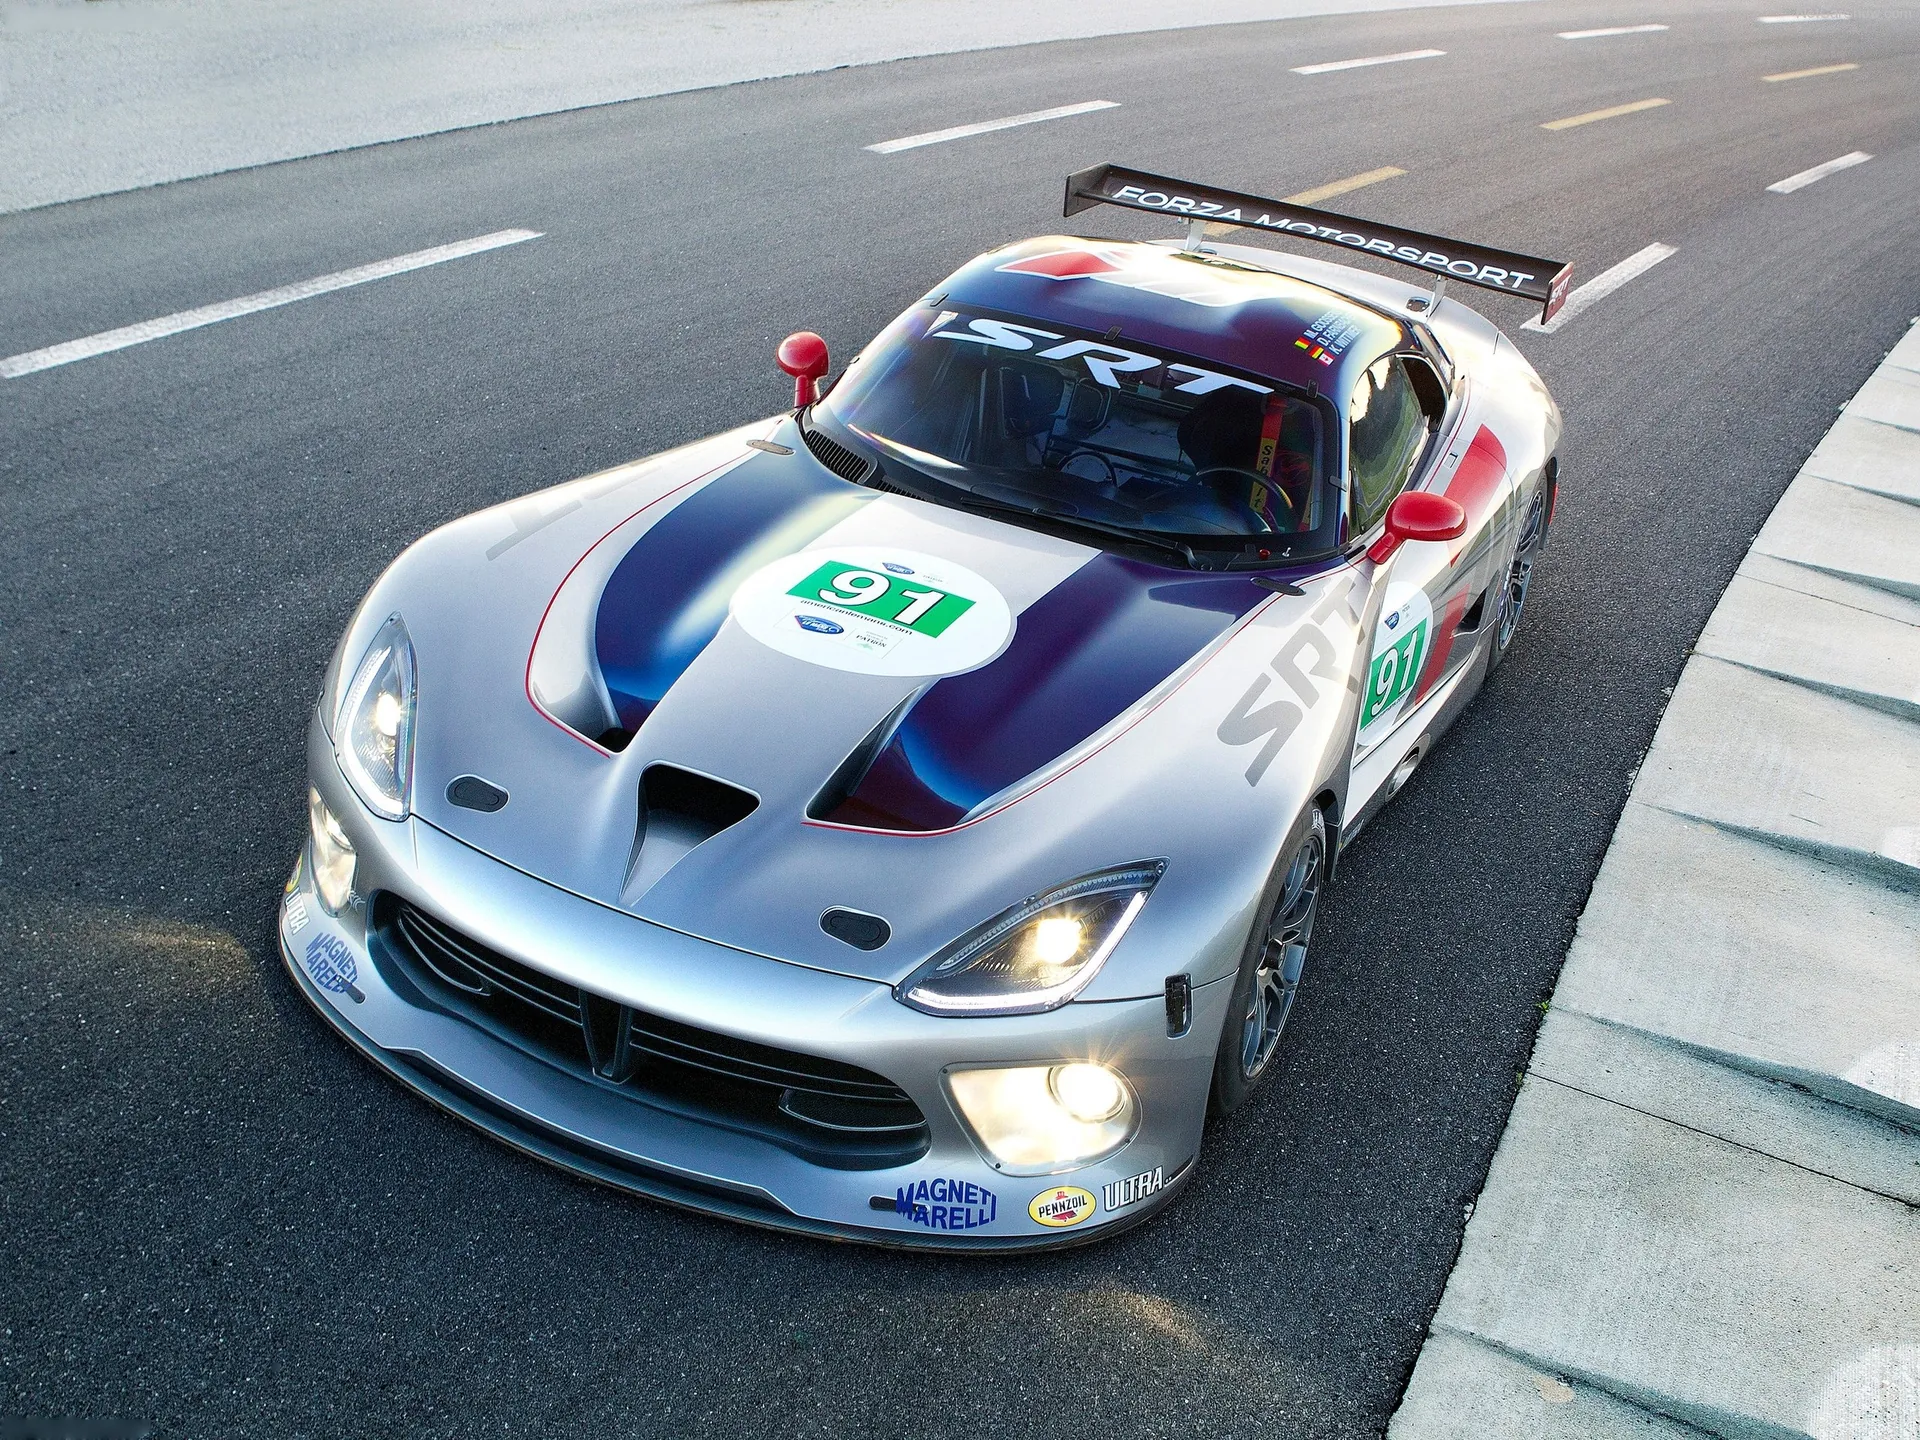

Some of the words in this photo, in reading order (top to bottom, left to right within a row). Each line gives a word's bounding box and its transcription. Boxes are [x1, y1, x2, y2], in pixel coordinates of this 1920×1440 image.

[1112, 185, 1241, 222] FORZA
[1254, 212, 1535, 290] MOTORSPORT
[932, 317, 1275, 396] SRT
[818, 569, 947, 627] 91
[1216, 575, 1366, 788] SRT
[1371, 627, 1420, 718] 91
[896, 1178, 997, 1212] MAGNETI
[896, 1201, 997, 1230] MARELLI
[1038, 1194, 1088, 1219] PENNZOIL
[1101, 1166, 1164, 1213] ULTRA
